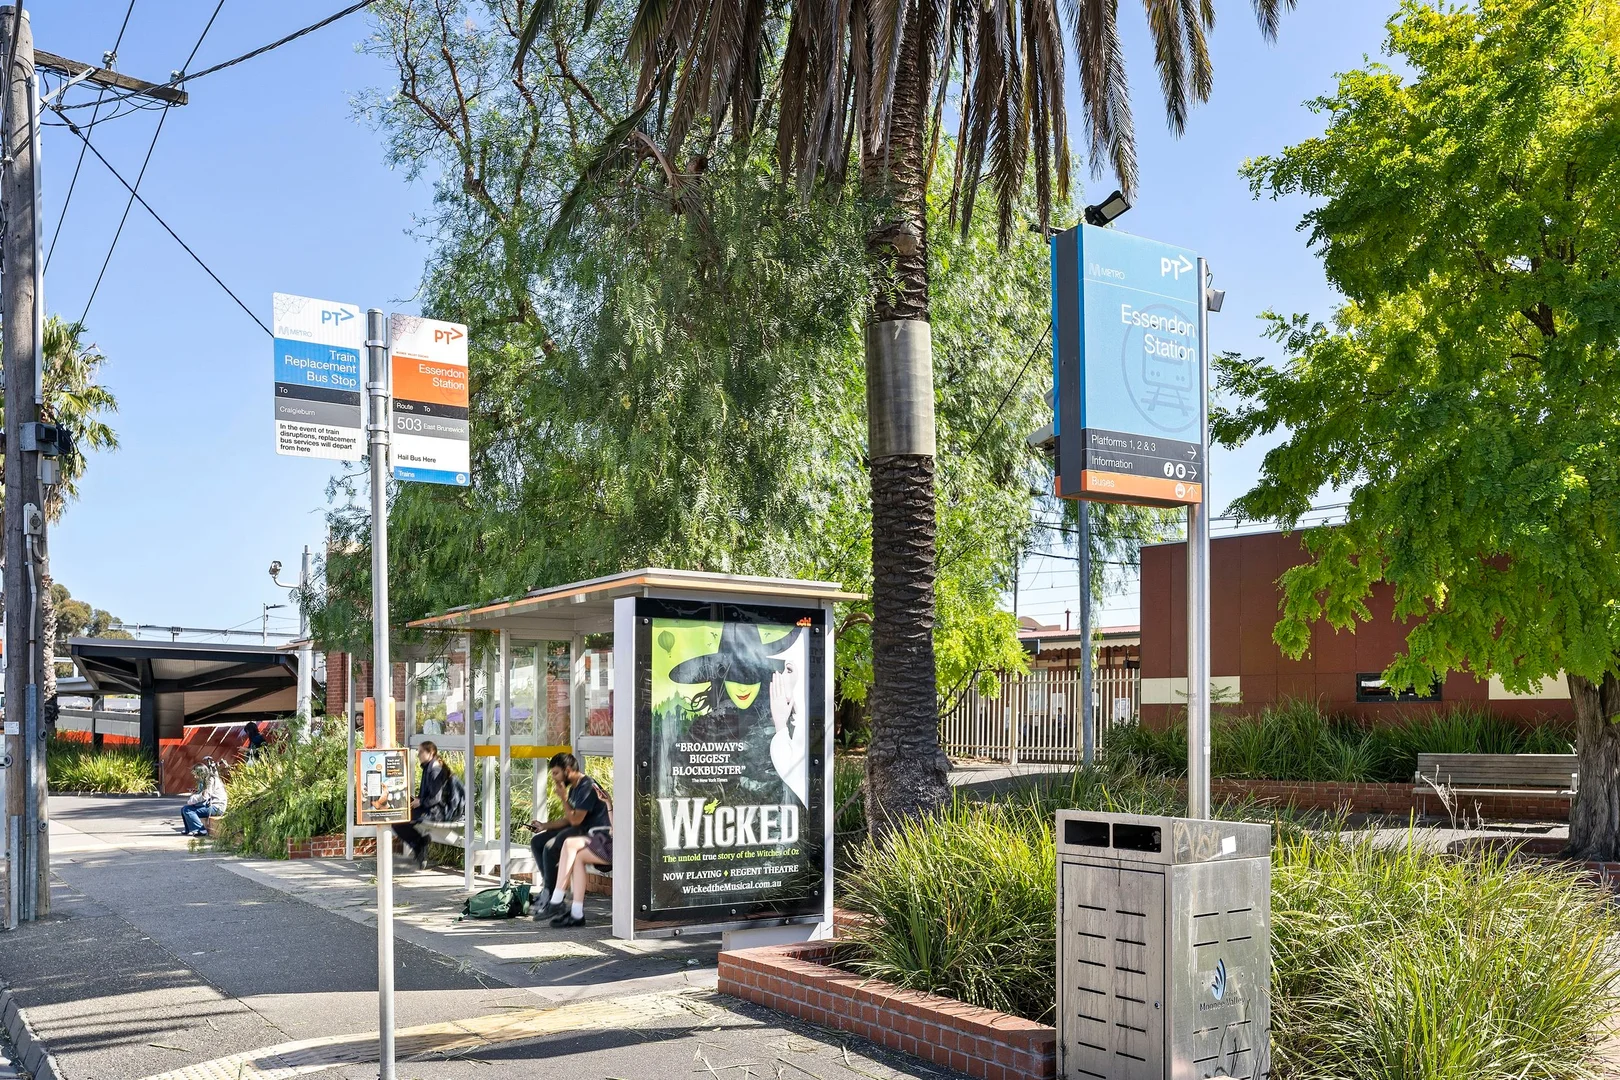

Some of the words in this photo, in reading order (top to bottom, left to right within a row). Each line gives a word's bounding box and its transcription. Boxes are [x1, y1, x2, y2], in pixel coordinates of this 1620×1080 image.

[1101, 267, 1125, 280] METRO
[1121, 304, 1196, 338] Essendon
[1144, 333, 1196, 362] Station
[329, 350, 356, 363] Train
[284, 355, 357, 374] Replacement
[418, 364, 465, 379] Essendon
[307, 371, 328, 383] Bus
[331, 374, 357, 387] Stop
[432, 377, 465, 391] Station
[279, 406, 316, 416] Craigieburn
[396, 402, 413, 411] Route
[397, 416, 422, 432] 503
[423, 423, 436, 431] East
[437, 424, 465, 434] Brunswick
[280, 431, 317, 440] disruptions,
[318, 434, 356, 444] replacement
[1091, 434, 1128, 448] Platforms
[1137, 441, 1142, 450] 2
[1144, 442, 1150, 450] &
[1150, 442, 1156, 452] 3
[332, 442, 352, 450] depart
[1091, 456, 1133, 470] Information
[398, 470, 415, 478] Trains
[1091, 476, 1115, 488] Buses
[689, 754, 730, 764] BIGGEST
[663, 855, 677, 863] The
[678, 854, 702, 863] untold
[718, 853, 735, 862] story
[736, 851, 744, 859] of
[744, 851, 756, 859] the
[756, 850, 782, 858] Witches
[663, 872, 684, 881] NOW
[686, 870, 722, 880] PLAYING
[730, 866, 762, 877] REGENT
[763, 864, 799, 874] THEATRE
[682, 880, 782, 894] WickedtheMusical.com.au
